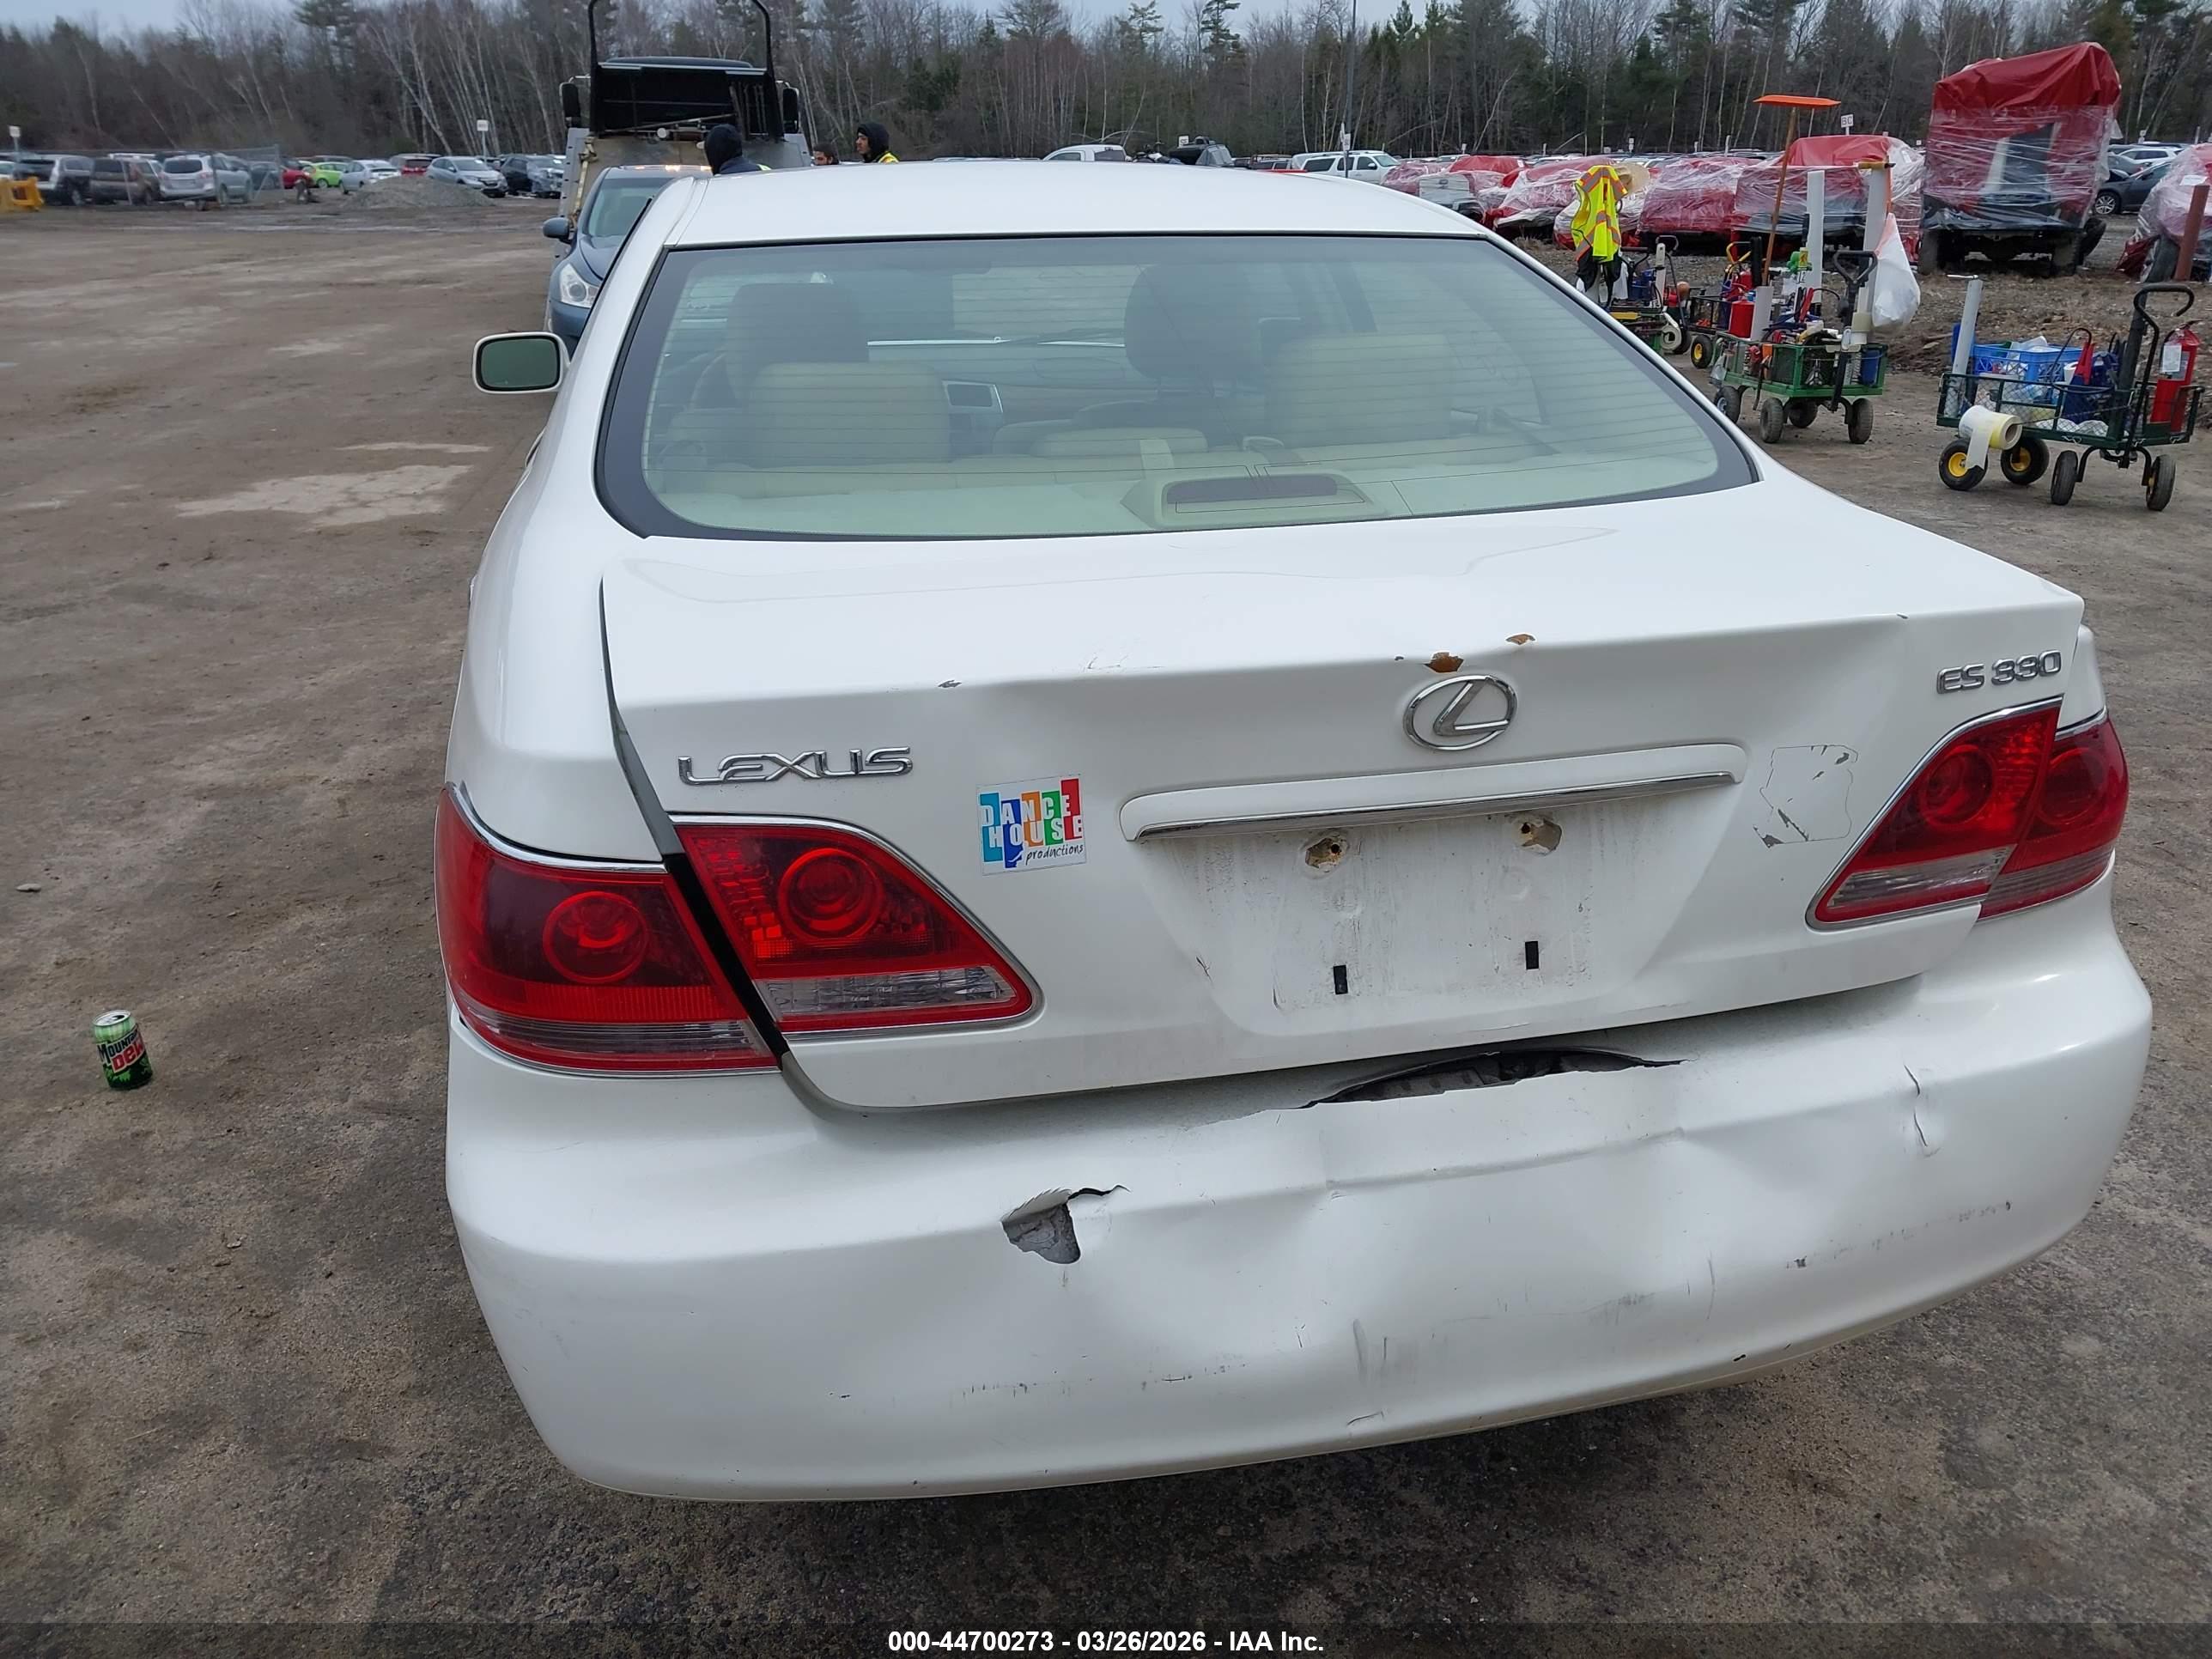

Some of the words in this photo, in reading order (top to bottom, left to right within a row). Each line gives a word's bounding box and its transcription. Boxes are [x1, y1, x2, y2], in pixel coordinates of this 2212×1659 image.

[1937, 663, 1984, 694] ES
[1990, 650, 2062, 685] 330
[678, 746, 914, 785] LEXUS
[980, 794, 1072, 826] DANCE
[989, 815, 1083, 848] HOUSE
[1025, 844, 1084, 866] productions
